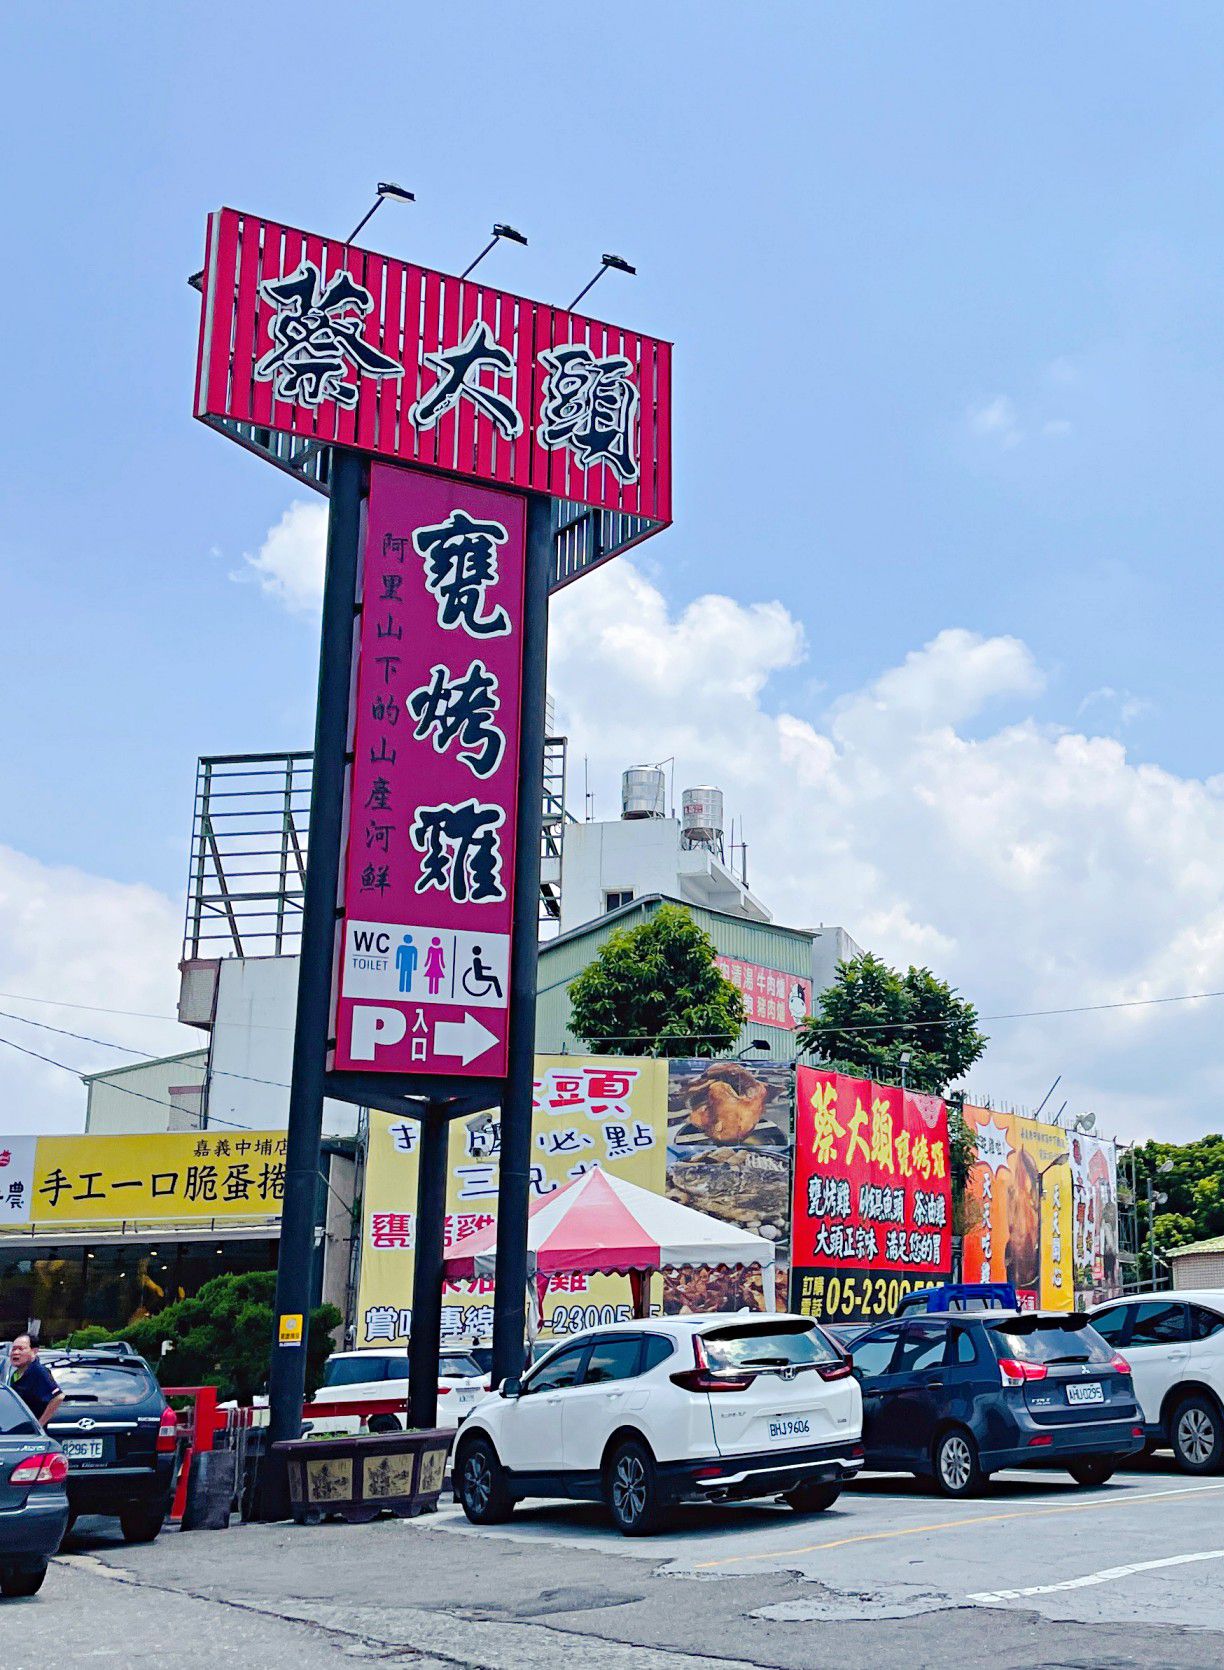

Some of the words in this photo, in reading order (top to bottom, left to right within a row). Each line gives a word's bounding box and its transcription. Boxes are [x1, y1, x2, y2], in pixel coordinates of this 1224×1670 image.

[254, 259, 640, 485] 蔡大頭
[360, 532, 408, 895] 阿里山下的山產河鮮
[407, 508, 512, 904] 甕烤雞
[352, 958, 389, 972] TOILET
[353, 930, 391, 955] WC
[411, 1008, 429, 1062] 入口
[193, 1138, 288, 1158] 嘉義中埔店
[810, 1081, 895, 1175] 蔡大頭
